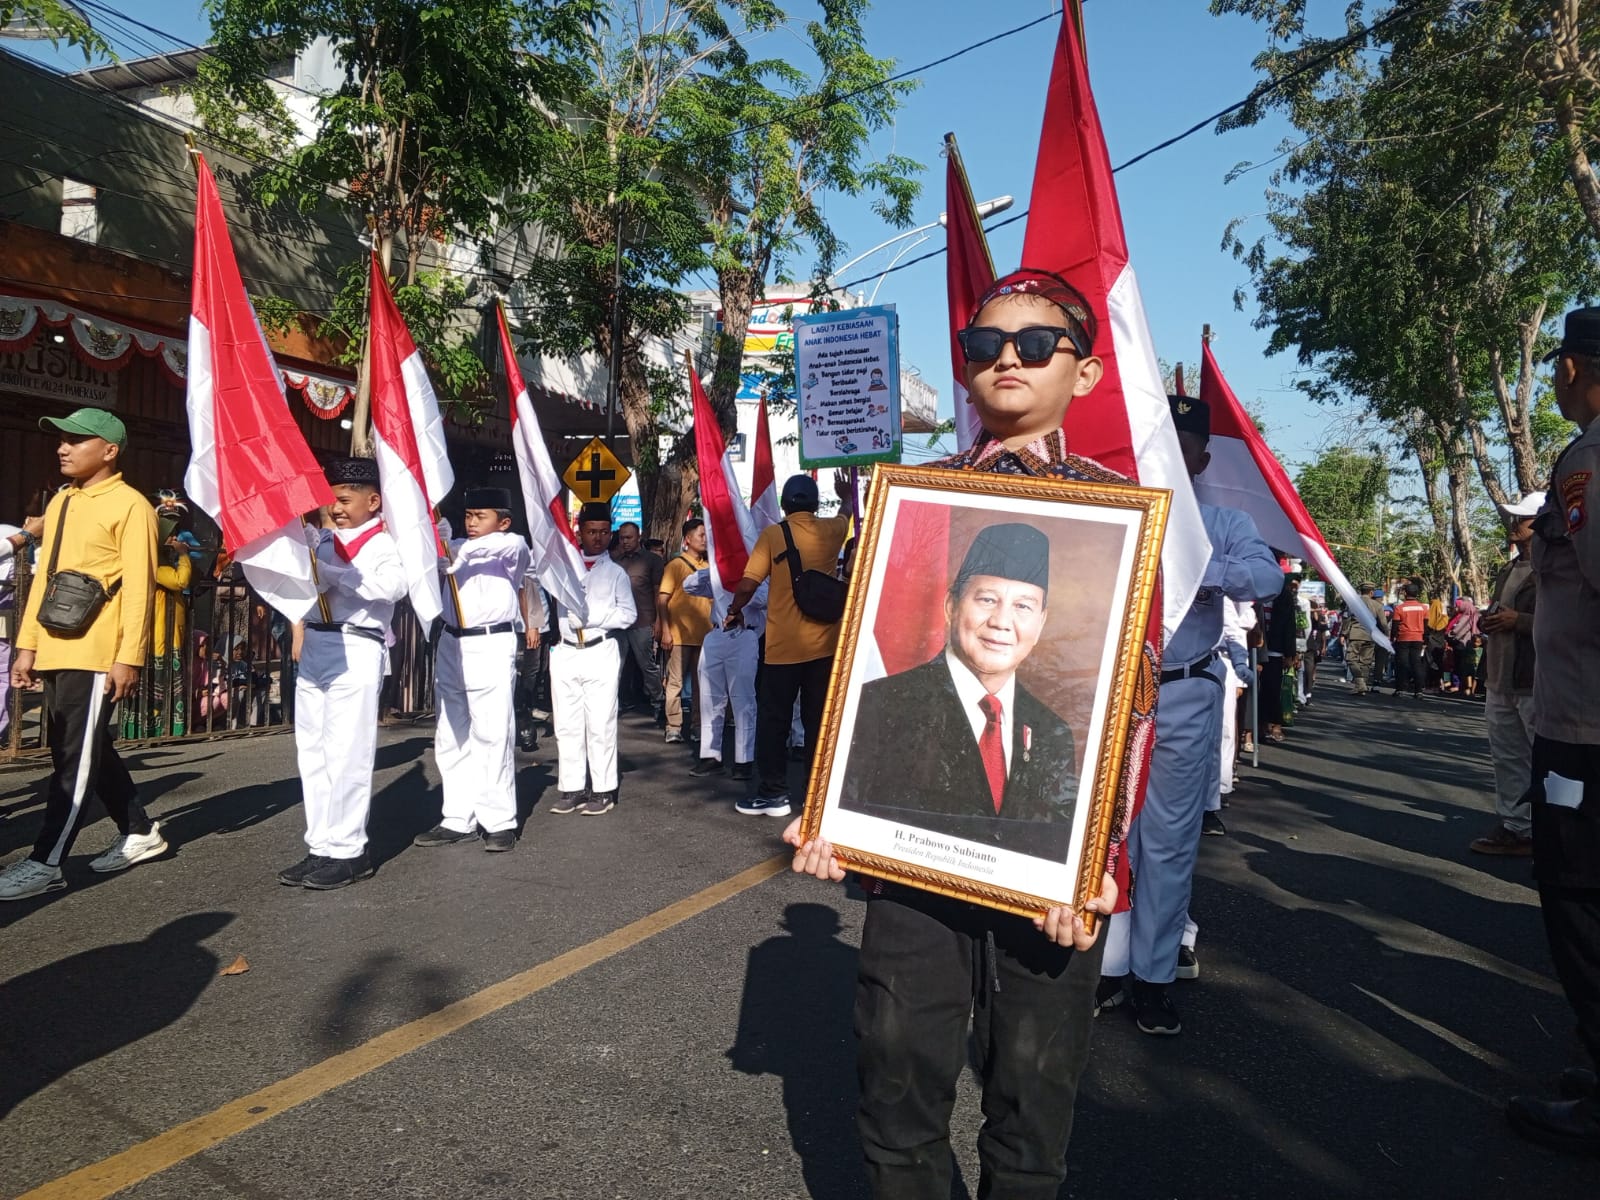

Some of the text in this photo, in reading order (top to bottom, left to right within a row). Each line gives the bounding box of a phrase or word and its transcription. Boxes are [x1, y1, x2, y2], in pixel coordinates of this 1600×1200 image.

[811, 325, 829, 334] LAGU
[837, 320, 874, 331] KEBIASAAN
[804, 330, 882, 346] ANAK INDONESIA HEBAT
[838, 358, 862, 366] Indonesia
[856, 367, 868, 376] pagi
[894, 830, 997, 864] H. Prabowo Subianto
[892, 842, 995, 876] Presiden Republik Indonesia
